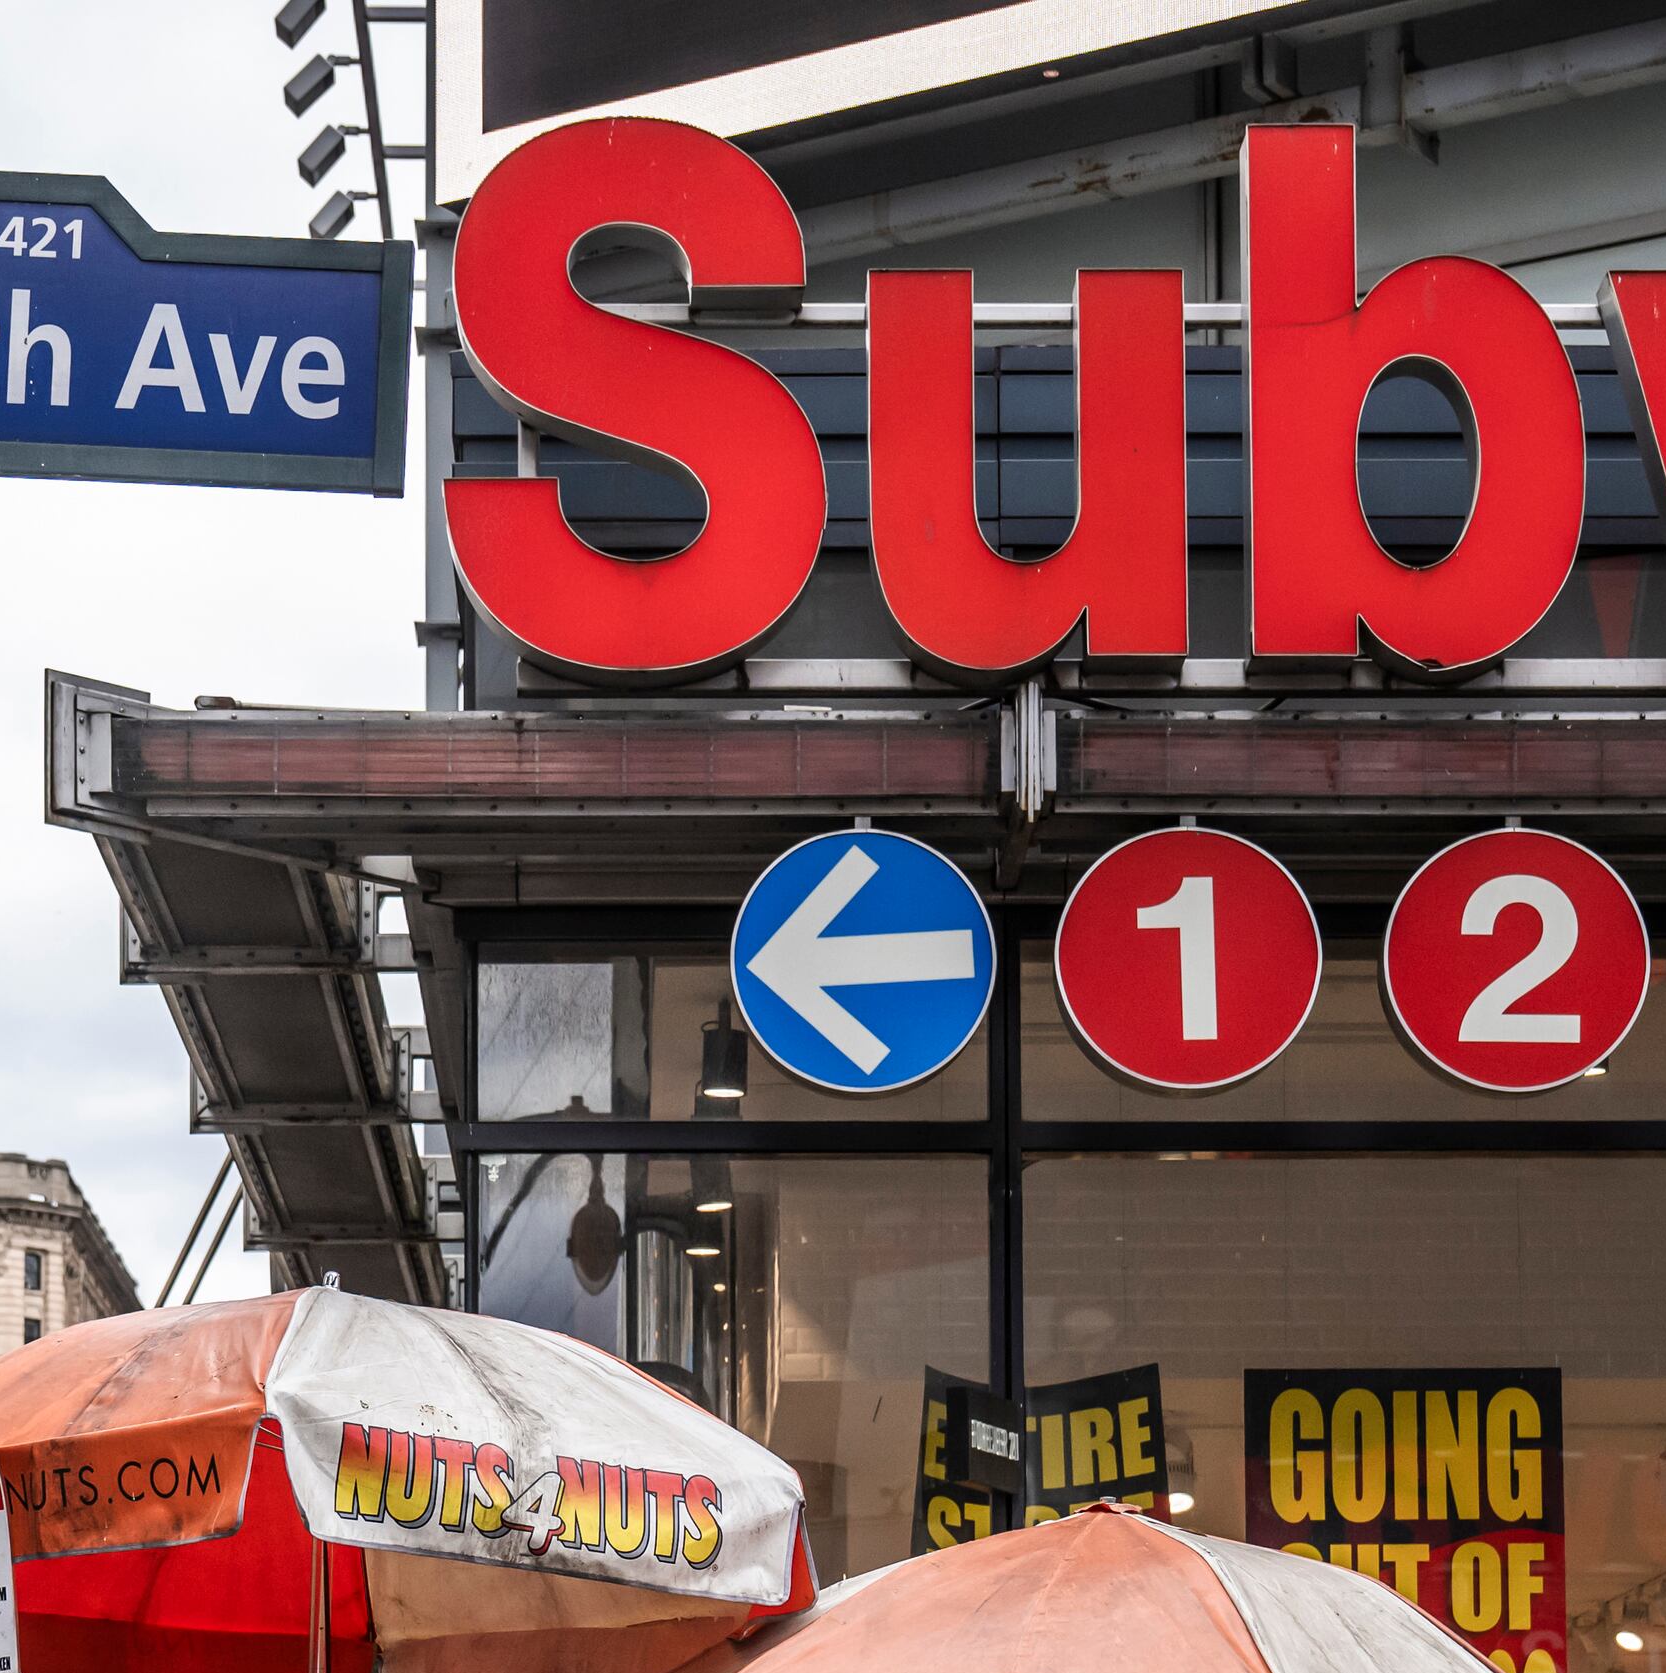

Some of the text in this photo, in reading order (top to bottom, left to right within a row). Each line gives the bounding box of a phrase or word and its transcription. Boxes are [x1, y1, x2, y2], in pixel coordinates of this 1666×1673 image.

[114, 302, 347, 420] Ave
[1136, 875, 1217, 1041] 1
[1458, 873, 1582, 1044] 2
[334, 1422, 723, 1571] NUTS4NUTS
[1269, 1387, 1544, 1524] GOING
[1451, 1541, 1545, 1633] OF
